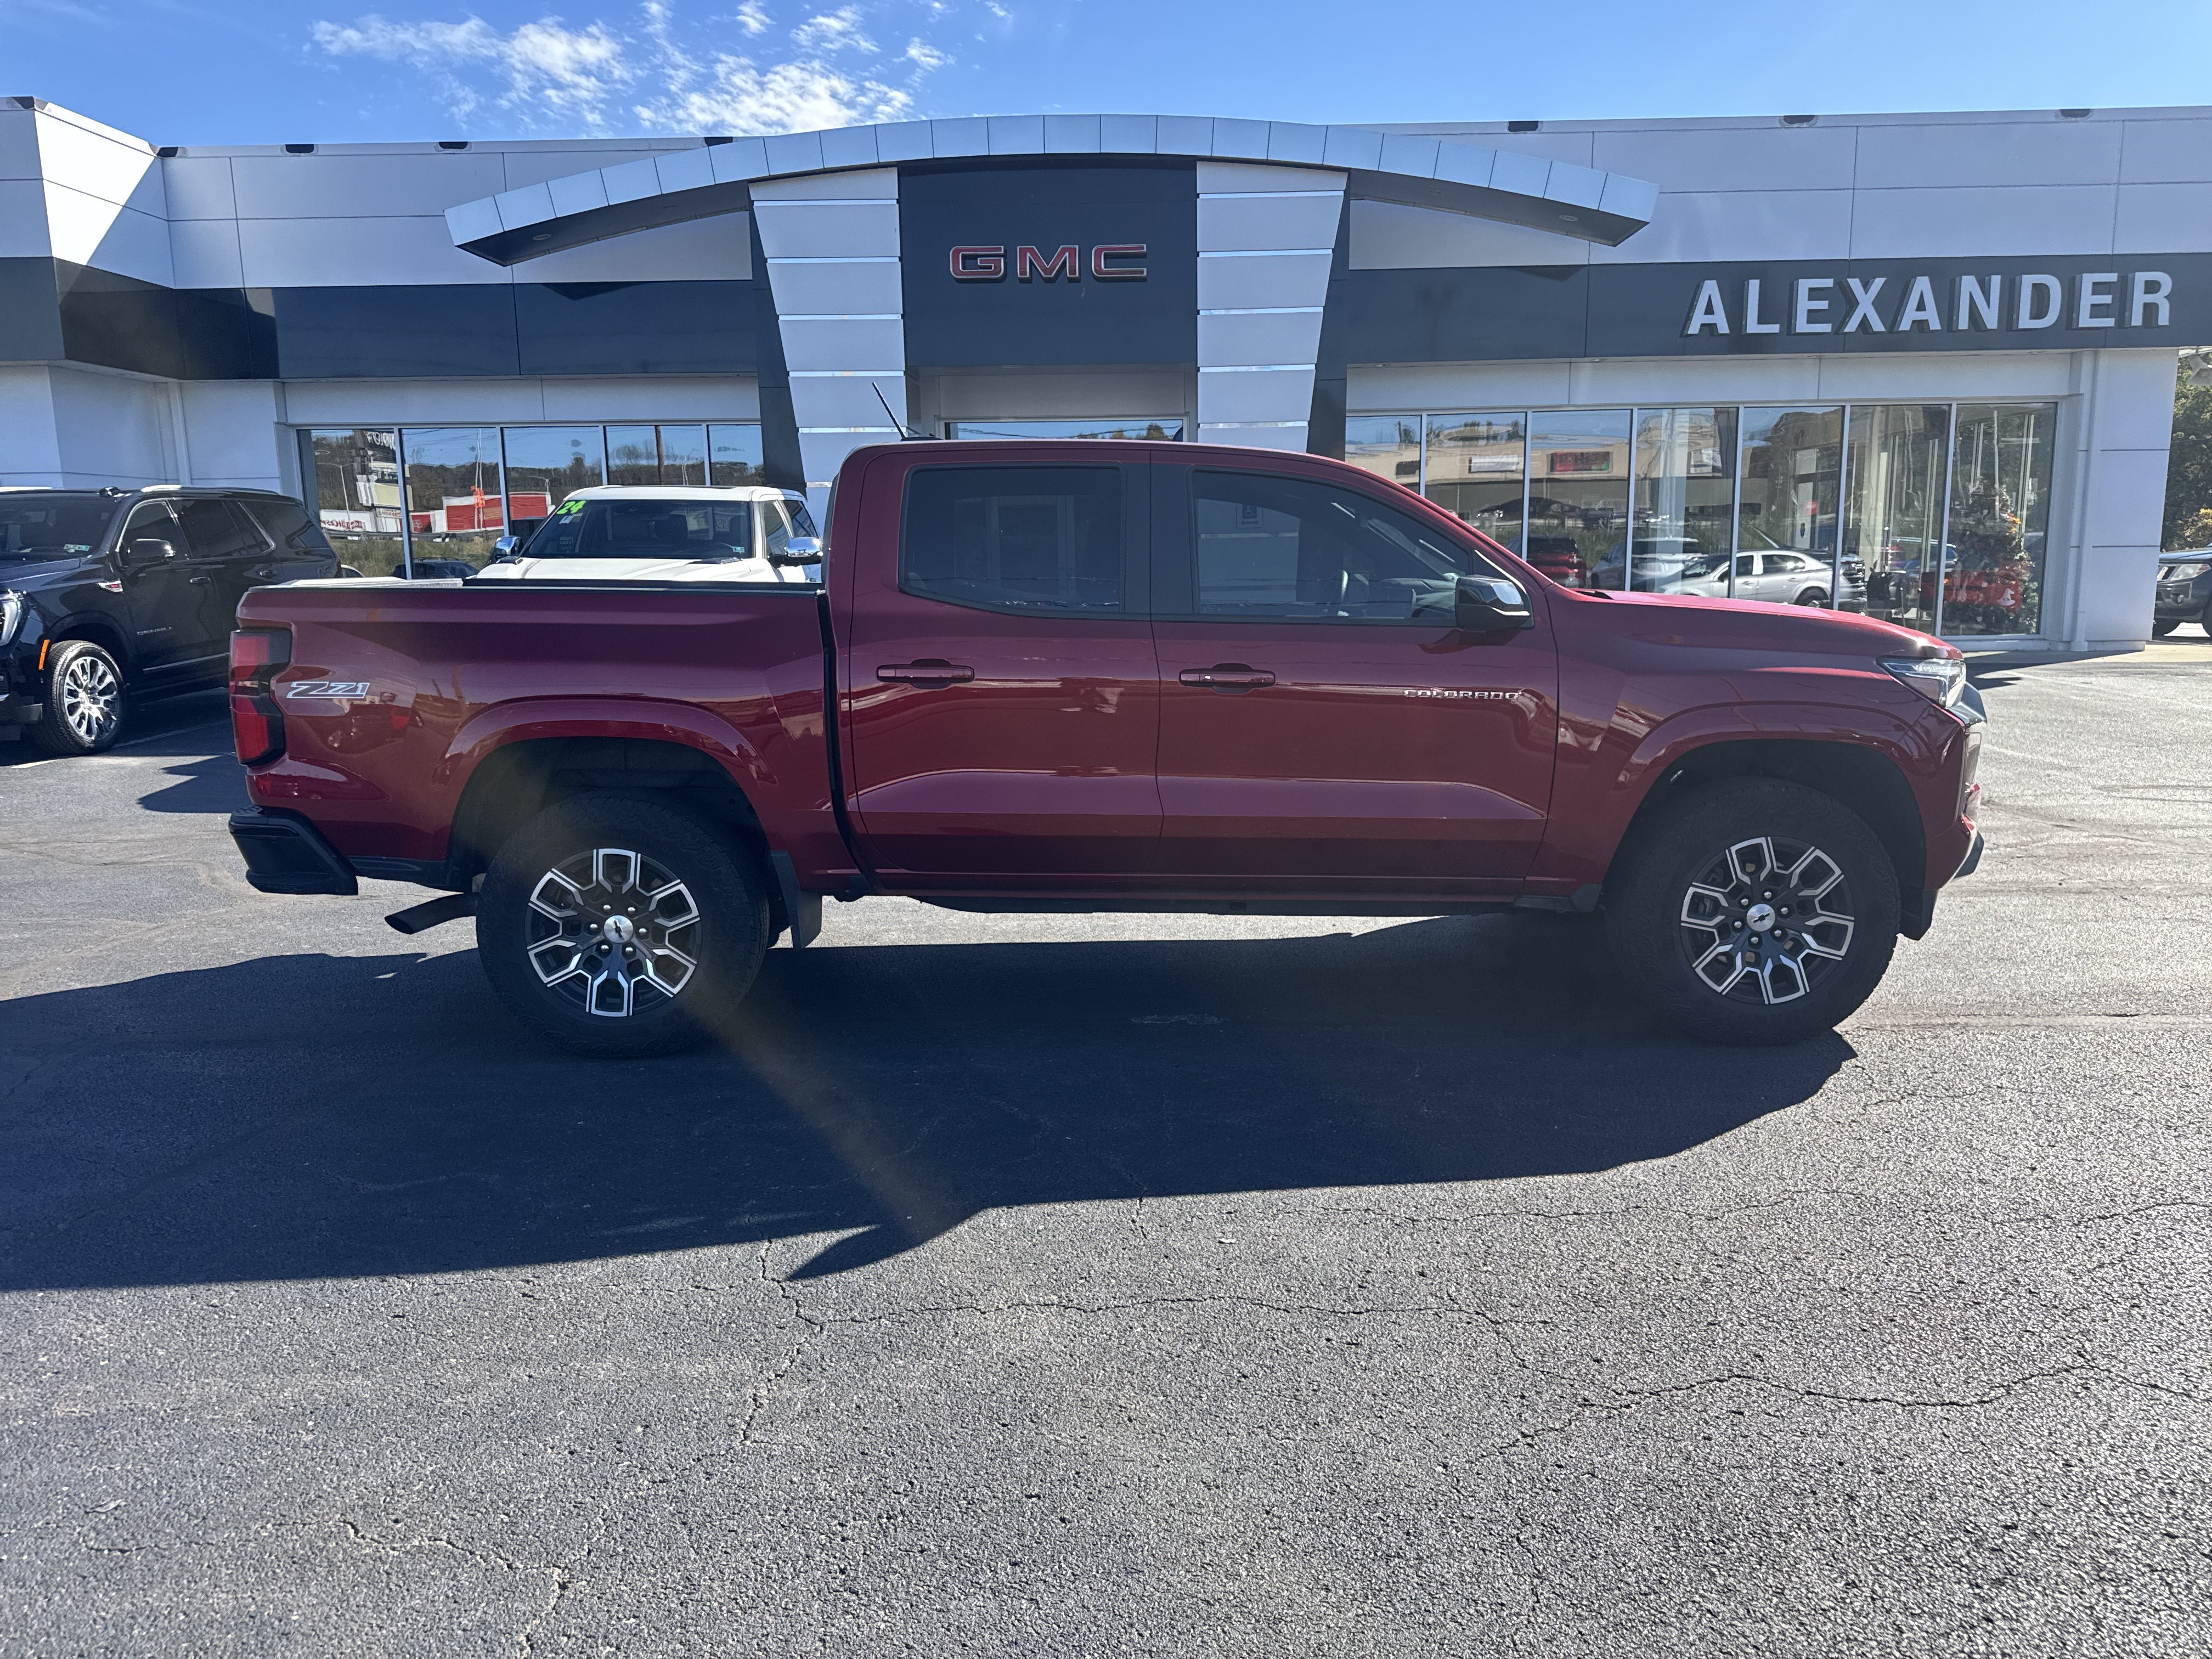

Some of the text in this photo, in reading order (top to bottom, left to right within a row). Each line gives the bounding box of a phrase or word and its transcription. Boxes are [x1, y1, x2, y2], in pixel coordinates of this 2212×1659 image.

[950, 244, 1147, 281] GMC
[1685, 271, 2173, 335] ALEXANDER
[556, 500, 586, 515] 24
[286, 681, 370, 699] Z71
[1403, 689, 1519, 699] COLORADO
